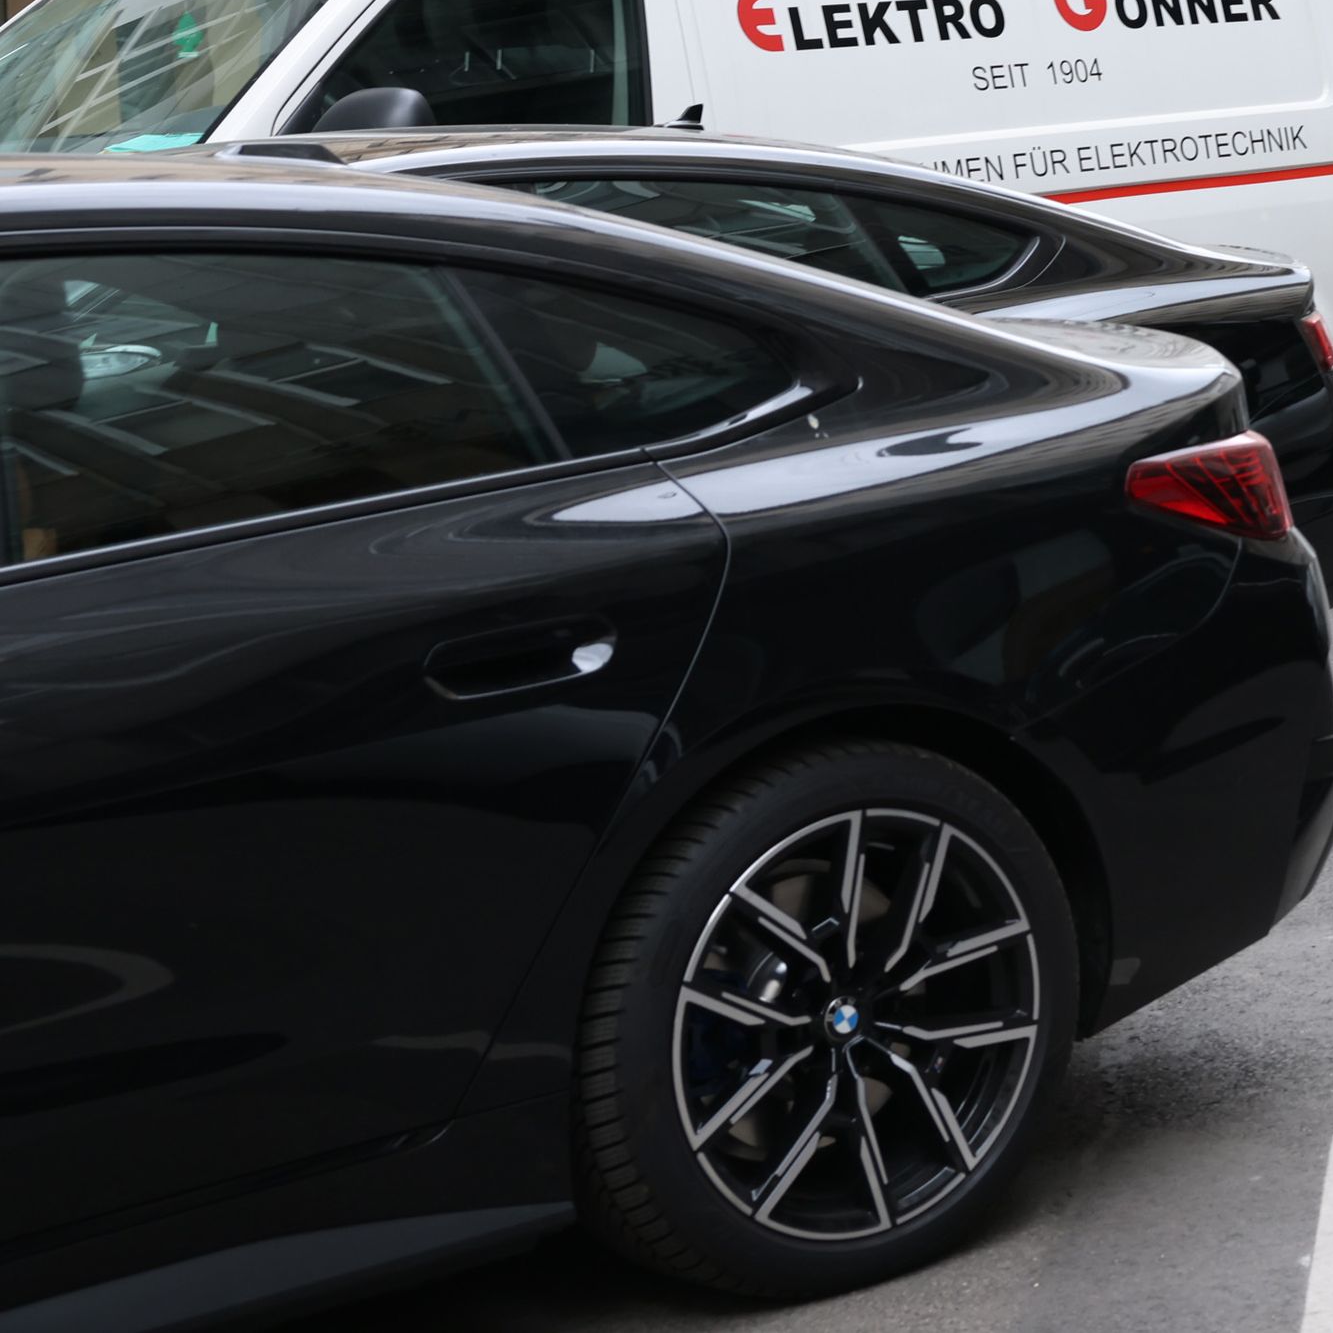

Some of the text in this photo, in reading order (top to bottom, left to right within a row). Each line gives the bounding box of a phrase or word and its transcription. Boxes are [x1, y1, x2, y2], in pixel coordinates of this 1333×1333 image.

[971, 57, 1103, 91] SEIT 1904
[1011, 146, 1069, 179] FÜR
[1077, 125, 1308, 173] ELEKTROTECHNIK
